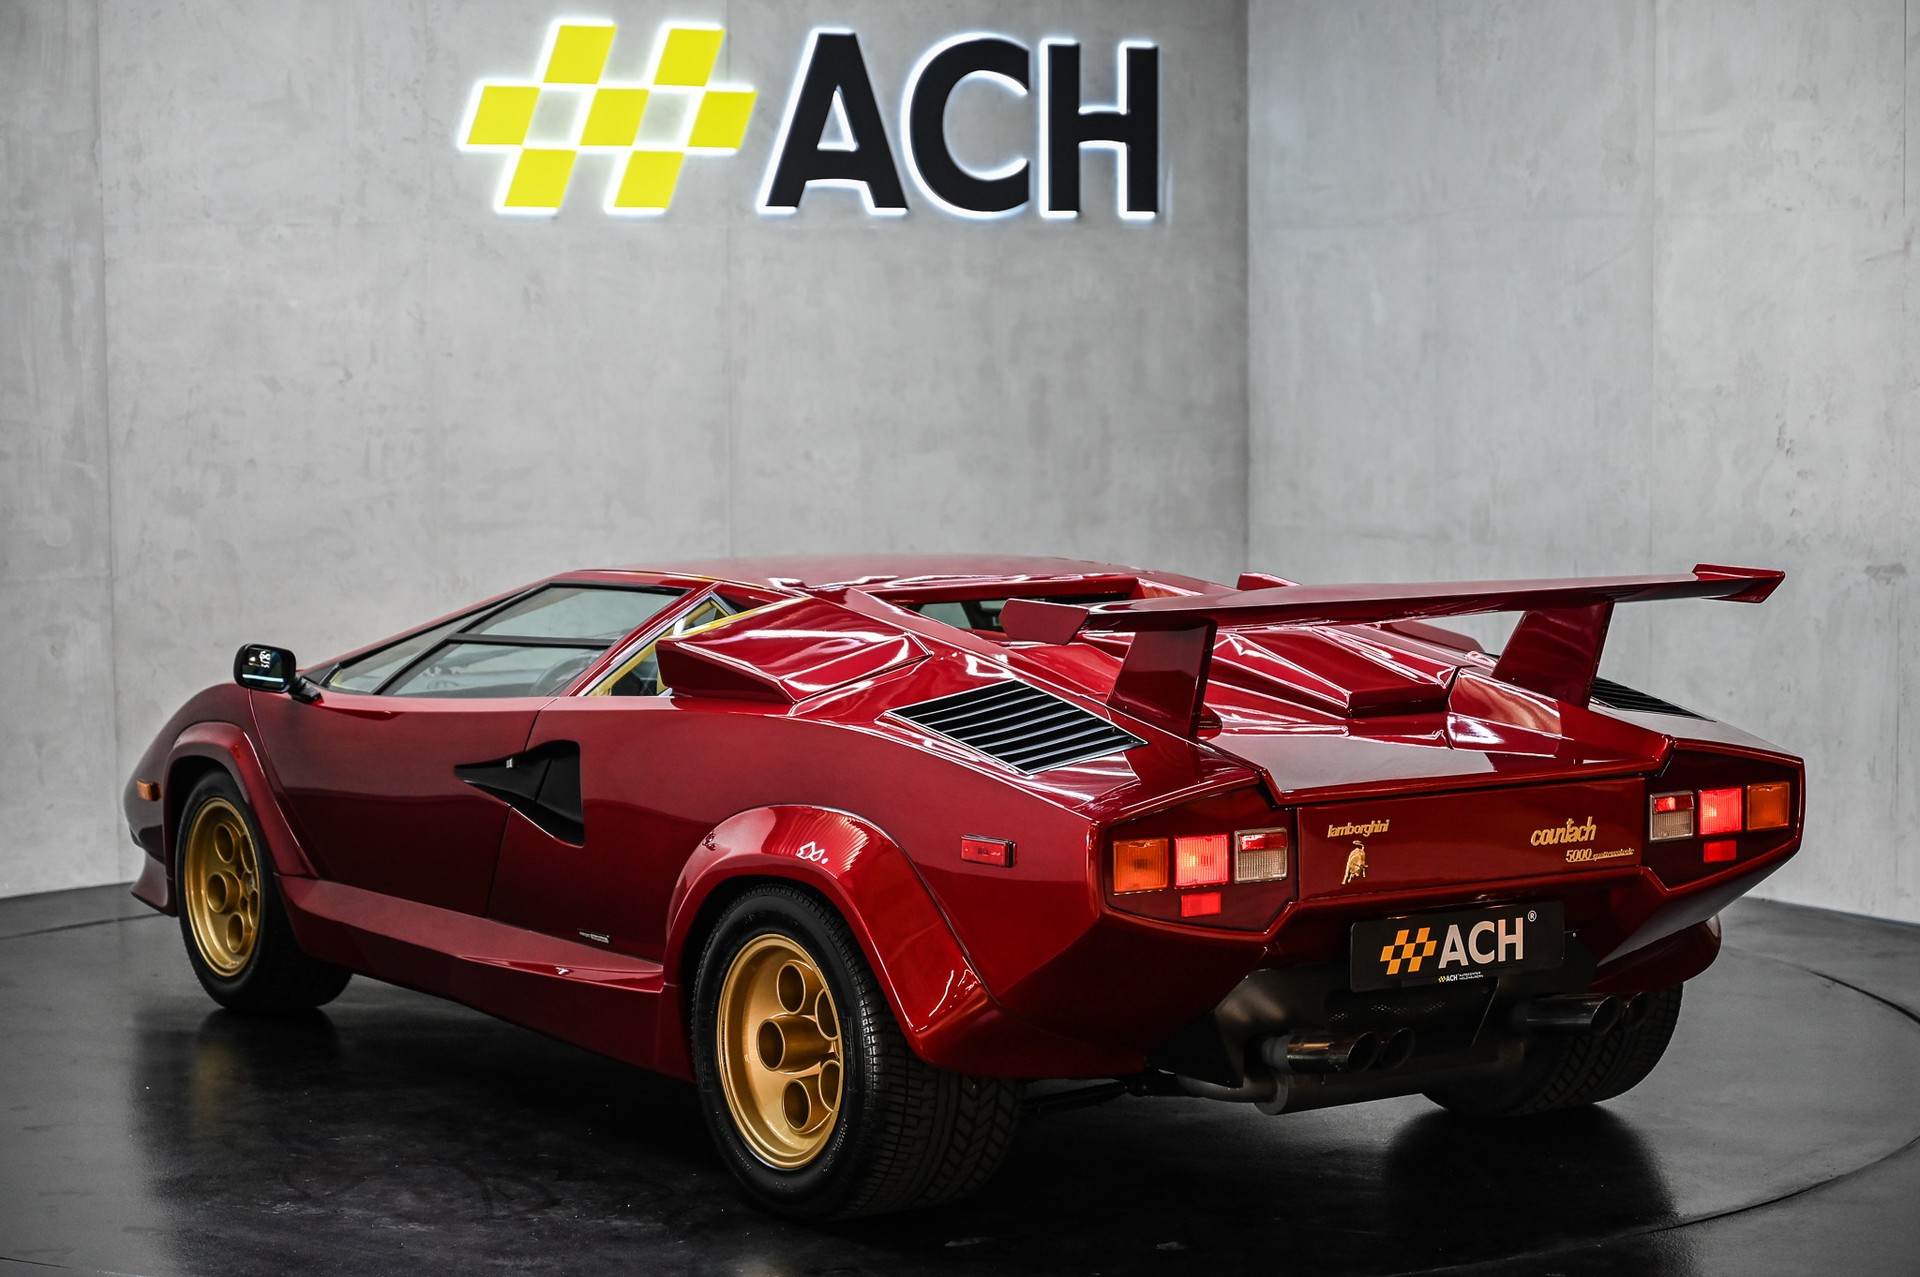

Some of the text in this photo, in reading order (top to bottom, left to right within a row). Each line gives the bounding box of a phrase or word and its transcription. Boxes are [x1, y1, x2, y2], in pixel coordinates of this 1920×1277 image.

[761, 29, 1158, 217] ACH
[1327, 819, 1389, 838] lamborghini
[1530, 816, 1597, 847] countach
[1565, 848, 1592, 862] 5000
